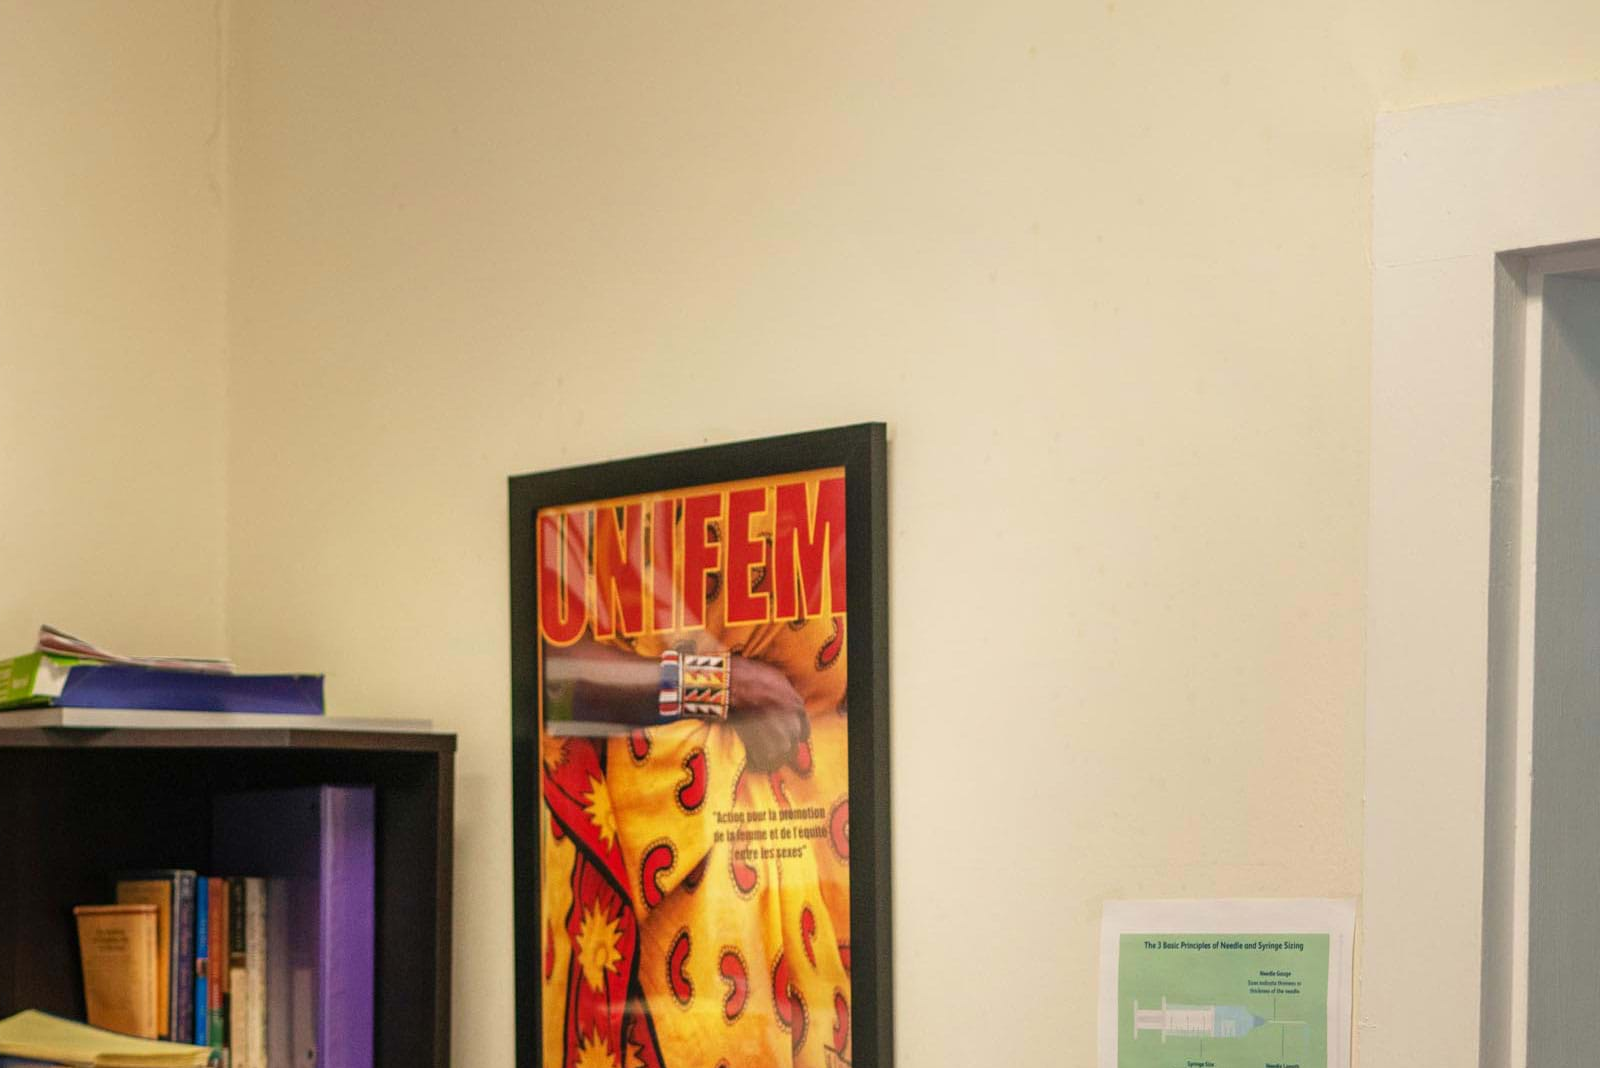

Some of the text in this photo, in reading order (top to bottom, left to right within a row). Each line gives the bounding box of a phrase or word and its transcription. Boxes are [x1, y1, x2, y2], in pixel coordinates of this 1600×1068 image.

[538, 477, 847, 647] UNIFEM
[747, 811, 766, 823] pour
[769, 808, 776, 821] la
[779, 808, 825, 821] promotion
[714, 831, 724, 842] de
[727, 830, 735, 841] la
[736, 829, 767, 841] femme
[770, 828, 779, 840] et
[781, 828, 791, 839] de
[735, 848, 758, 860] entre
[761, 848, 774, 859] les
[1181, 942, 1211, 950] Principles
[1258, 942, 1283, 951] Syringe
[1284, 942, 1304, 951] Sizing
